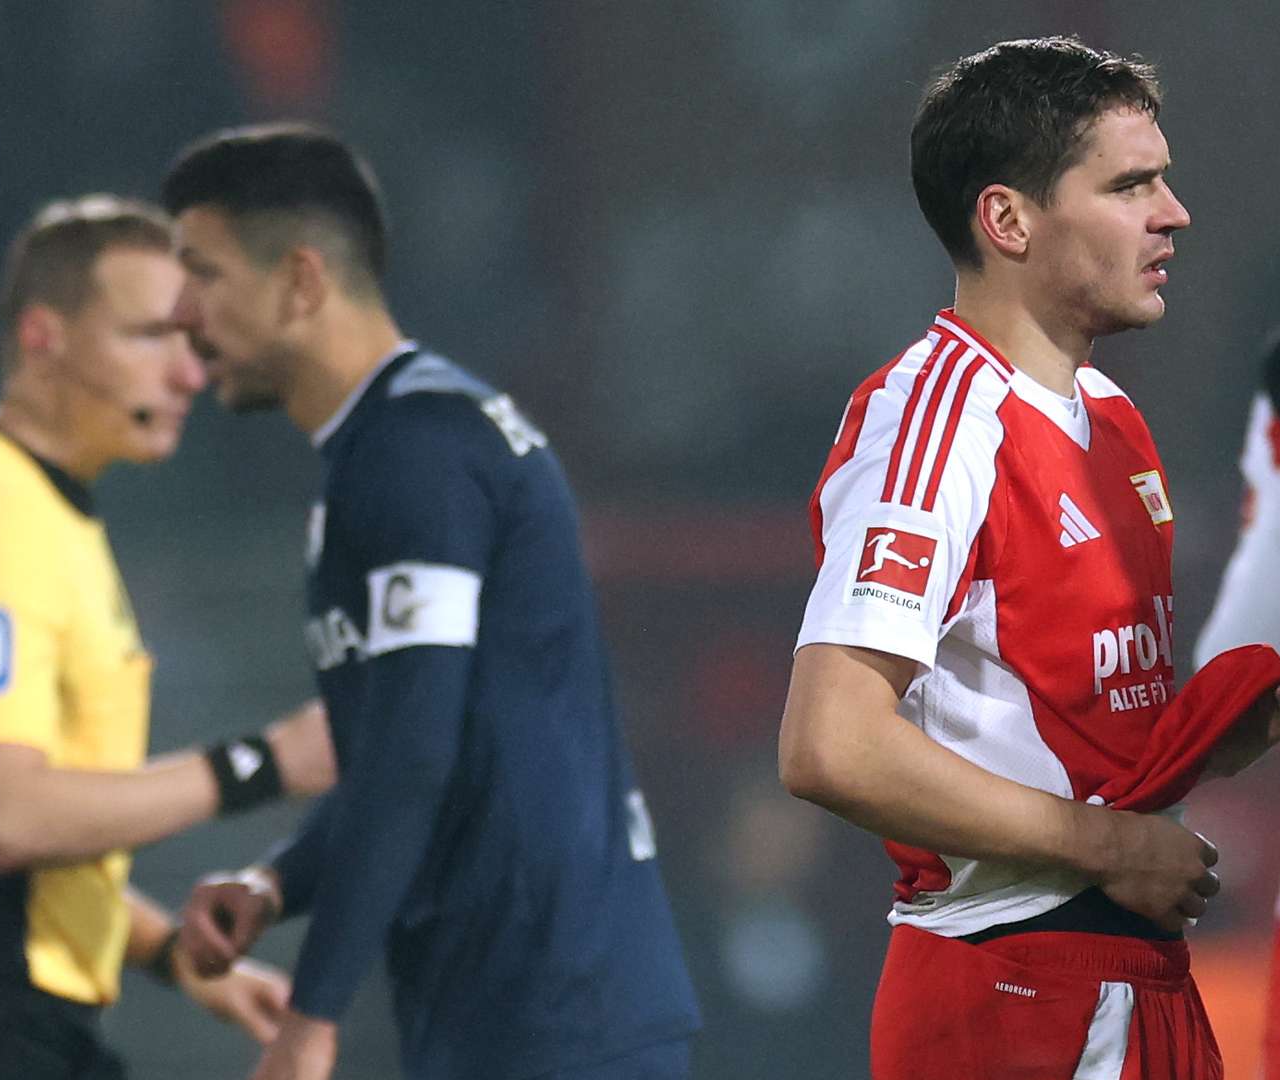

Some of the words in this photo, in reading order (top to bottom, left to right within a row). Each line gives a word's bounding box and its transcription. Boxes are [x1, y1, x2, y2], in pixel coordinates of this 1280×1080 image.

[852, 587, 921, 612] BUNDESLIGA
[1109, 684, 1151, 713] ALTE
[995, 981, 1037, 998] AEROREADY
